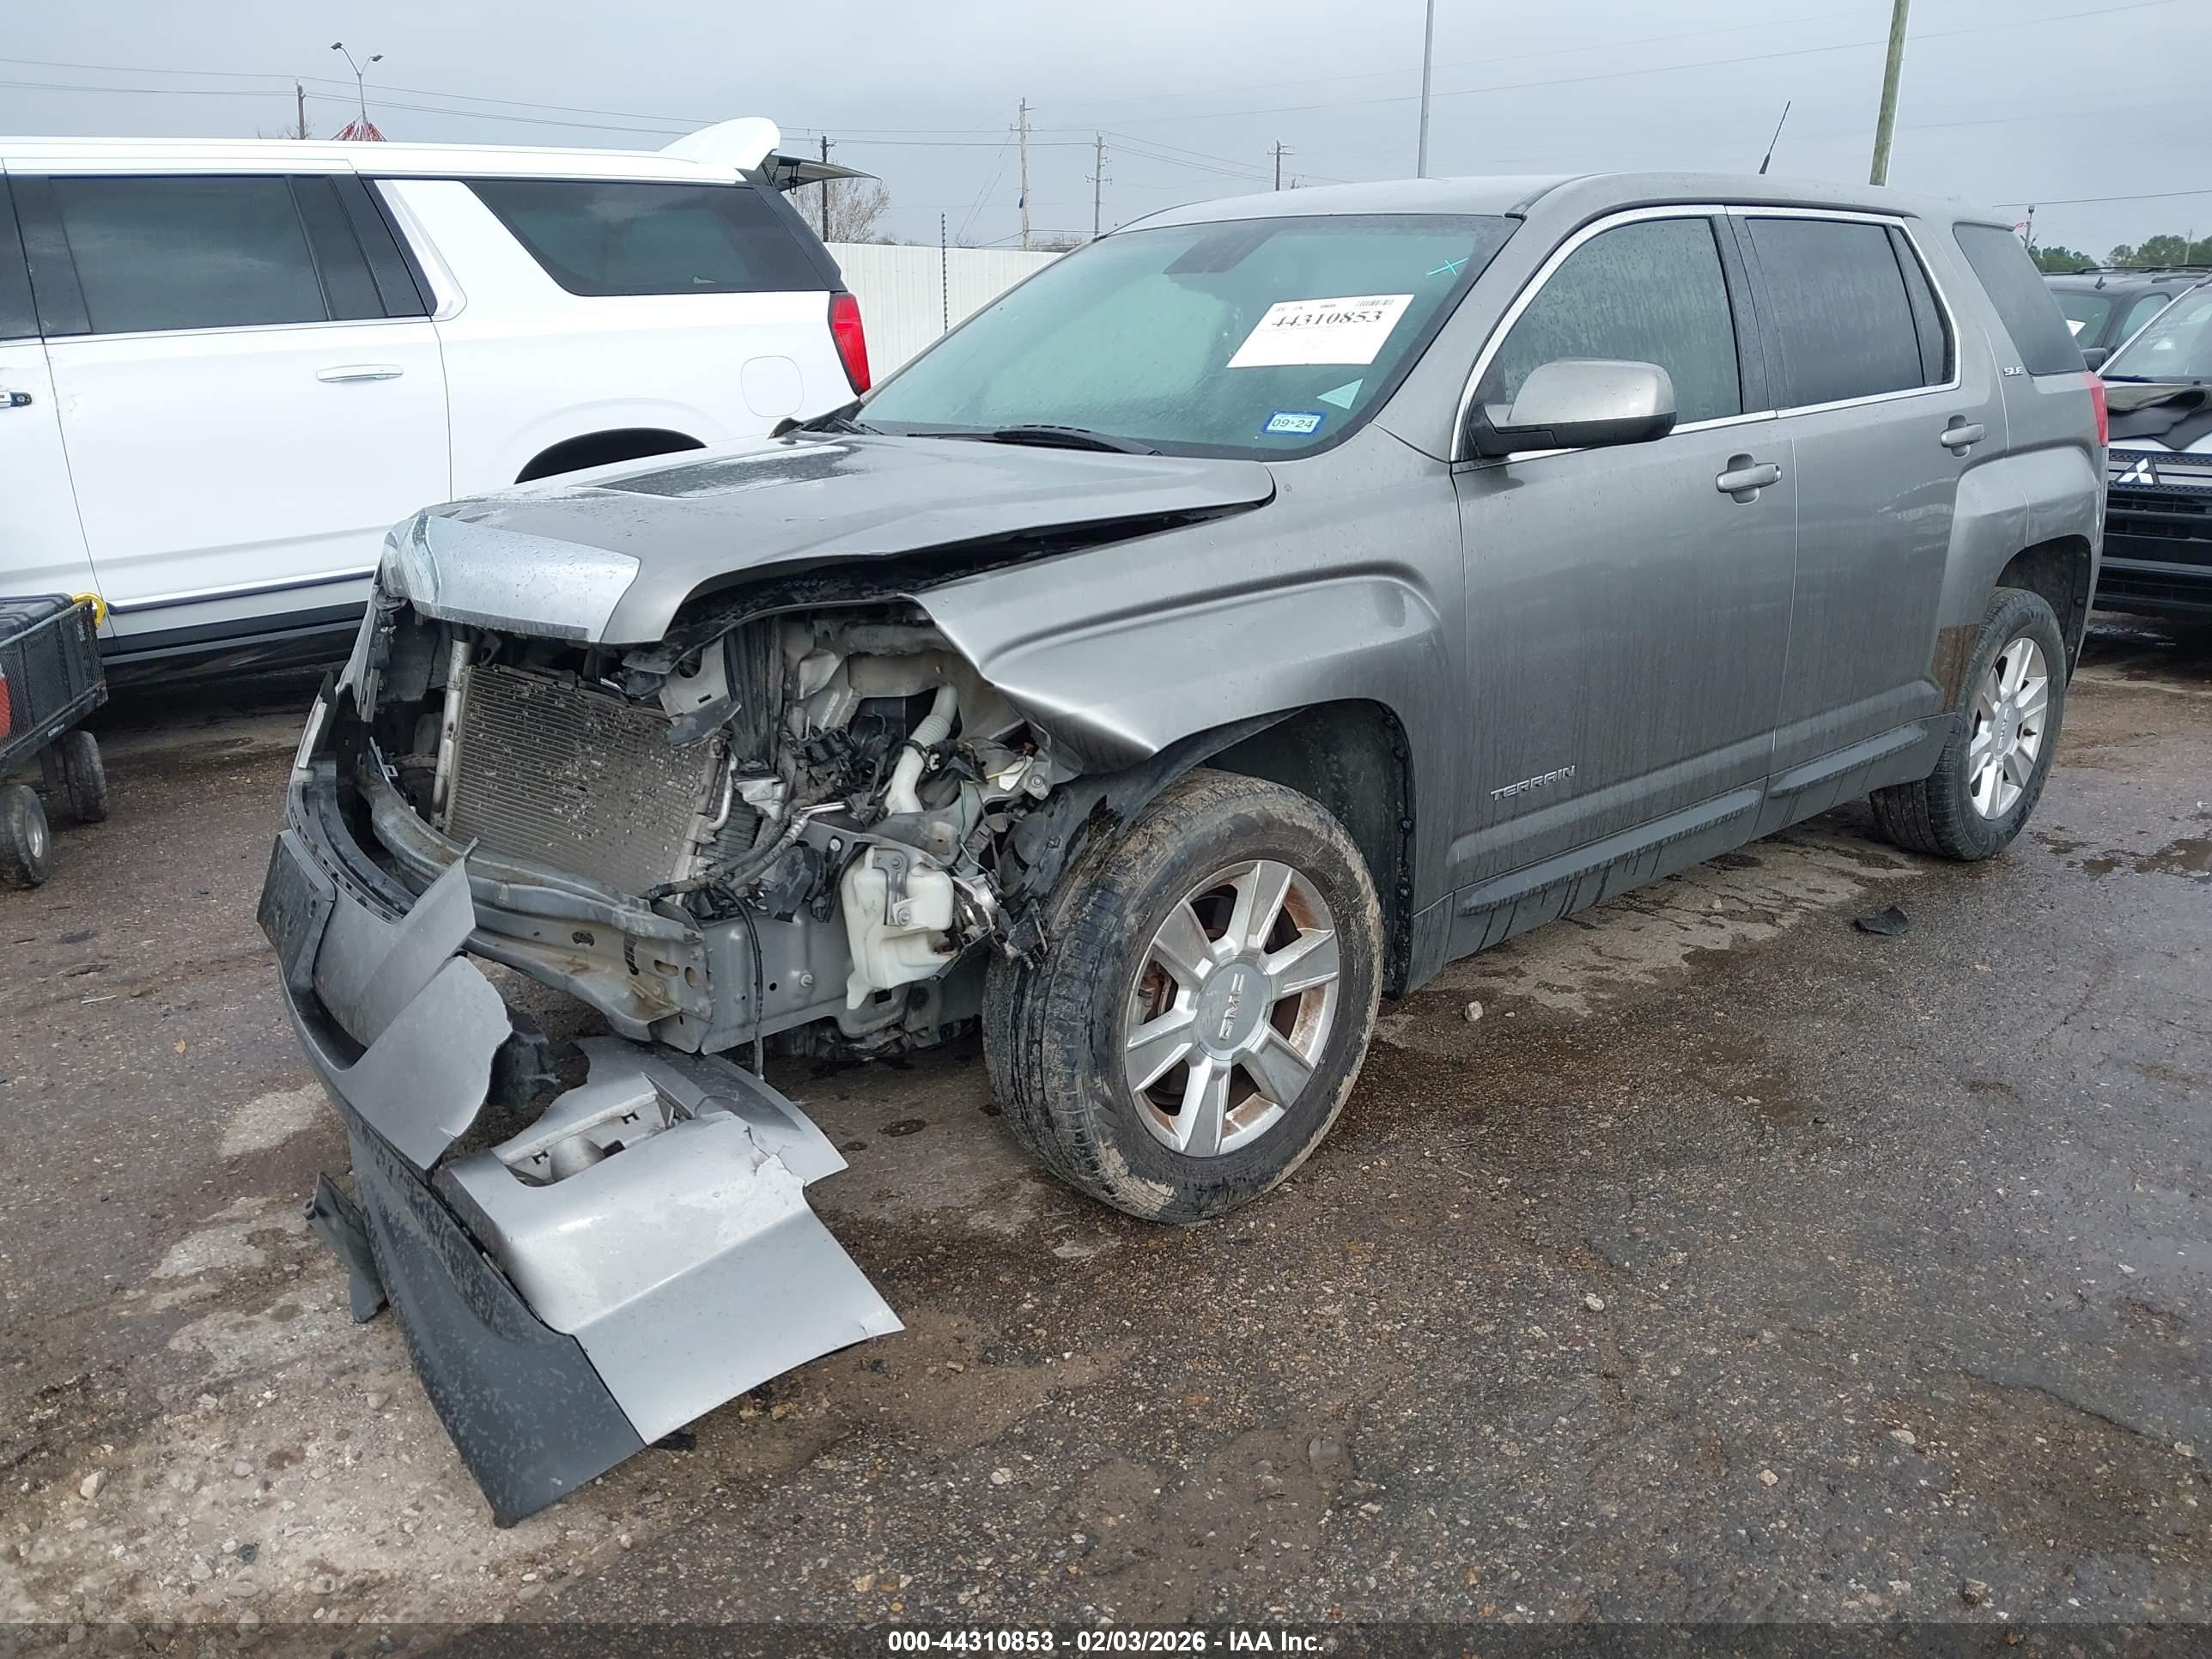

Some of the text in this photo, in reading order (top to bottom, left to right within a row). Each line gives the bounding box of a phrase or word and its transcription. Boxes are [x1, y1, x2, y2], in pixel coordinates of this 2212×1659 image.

[1272, 310, 1383, 327] 44310853
[1490, 765, 1576, 801] TERRAIN
[1218, 972, 1244, 1041] GMC
